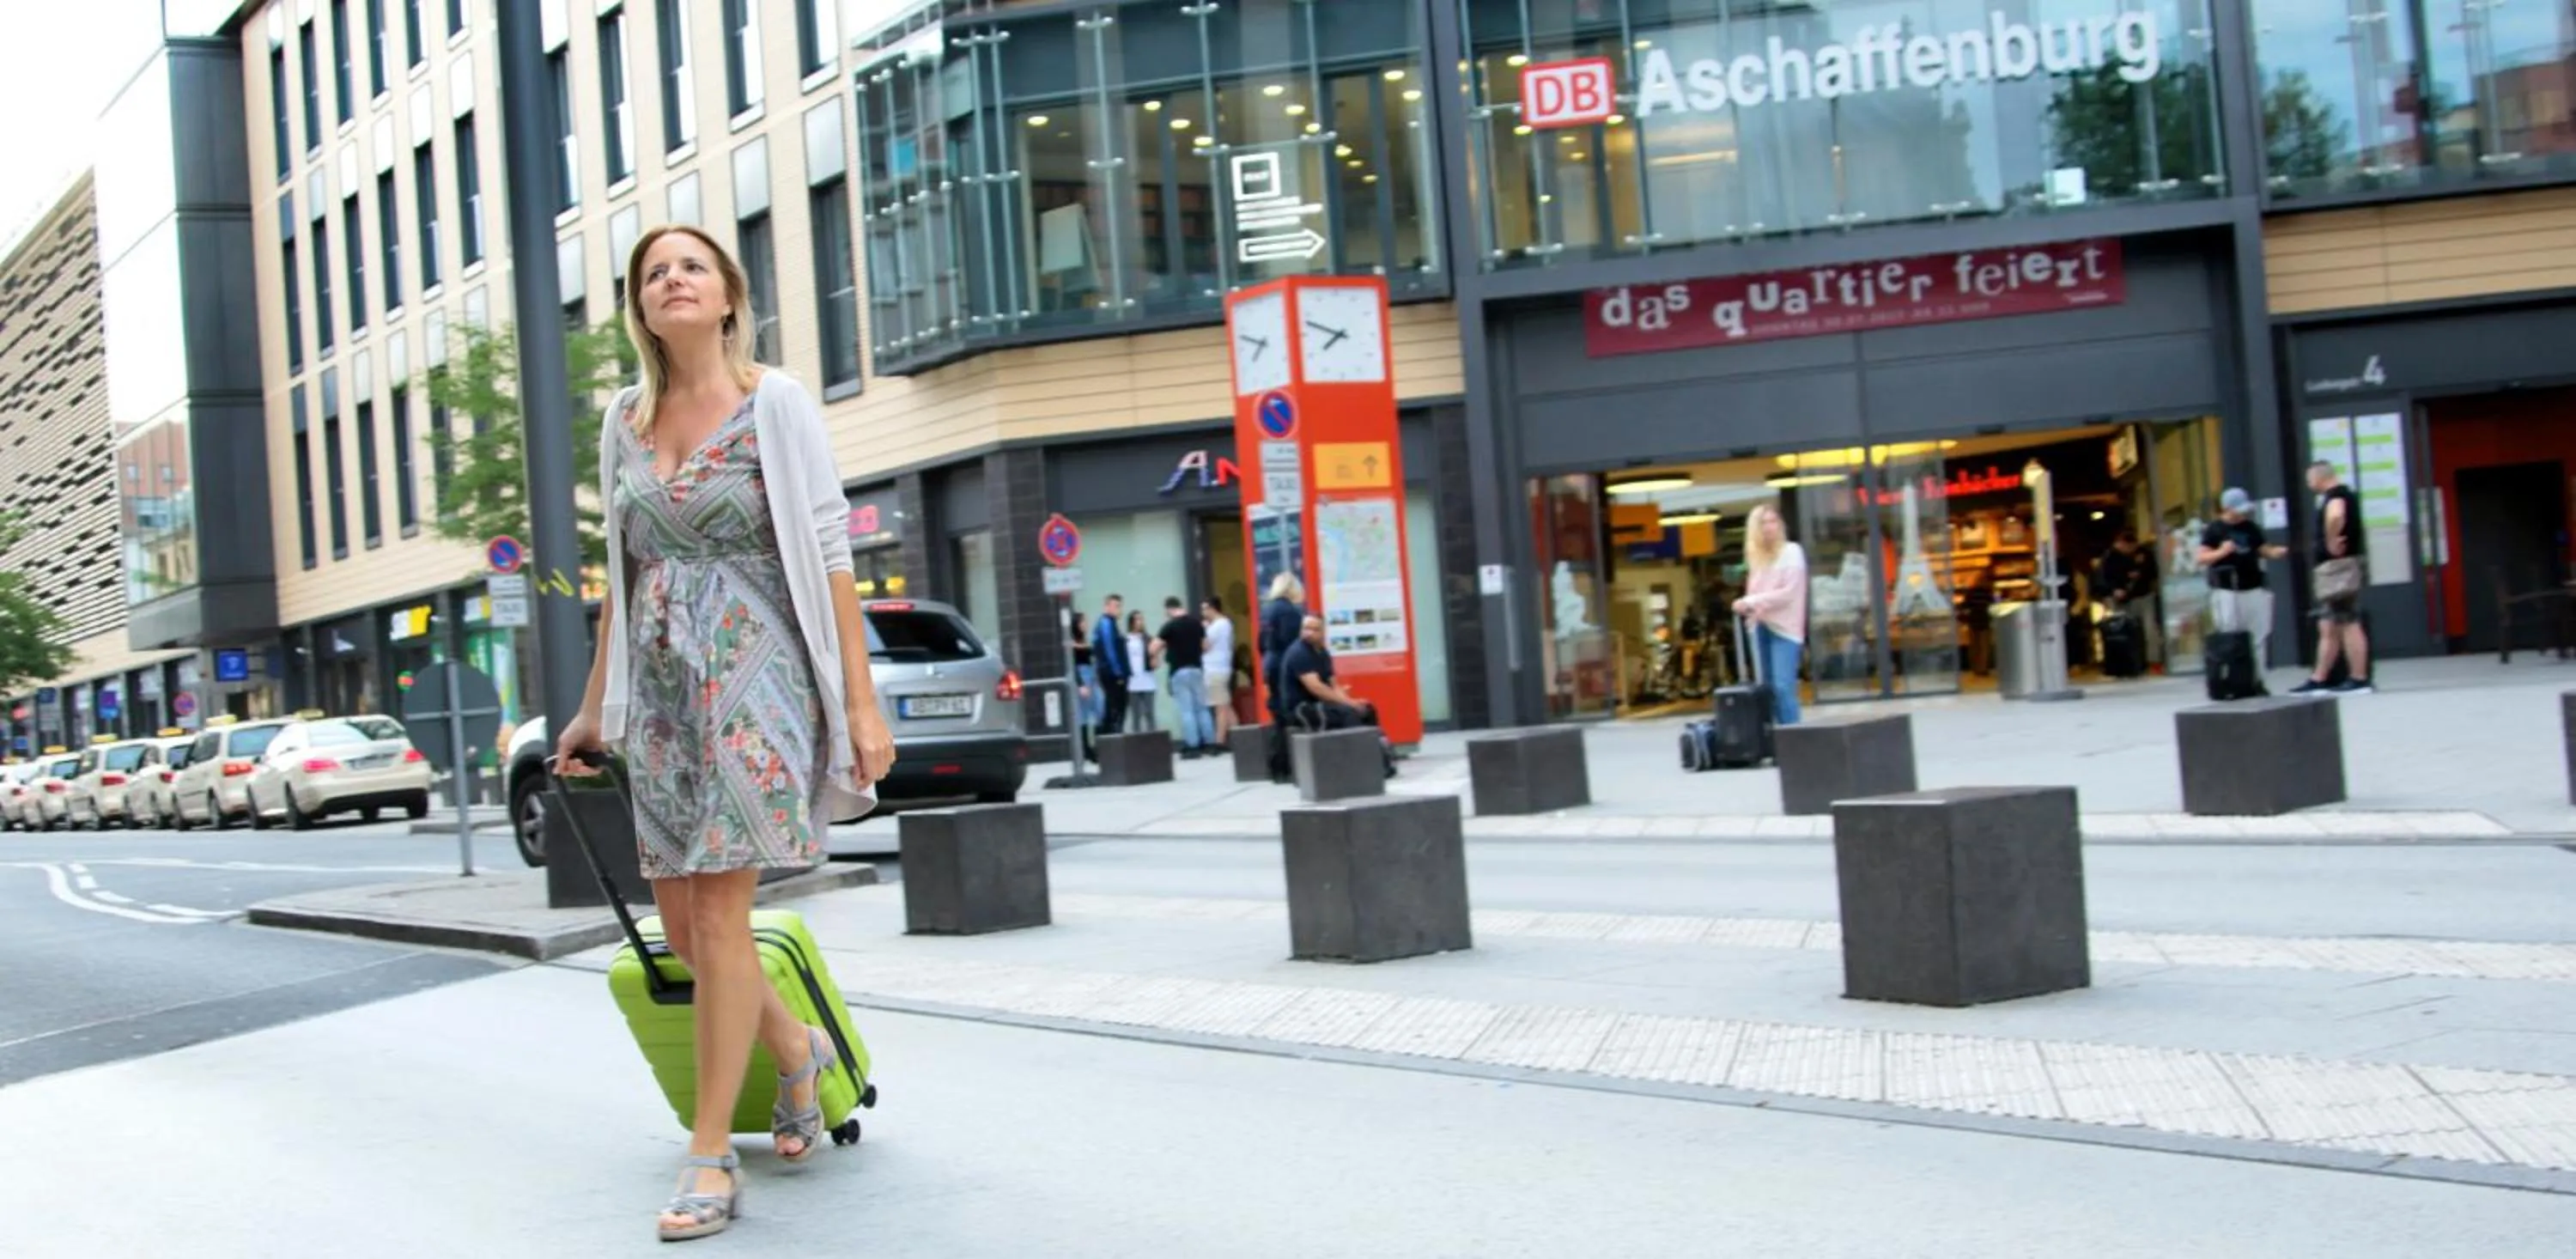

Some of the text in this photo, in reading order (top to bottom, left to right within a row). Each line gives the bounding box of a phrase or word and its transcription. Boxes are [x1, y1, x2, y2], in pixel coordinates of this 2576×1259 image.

[1534, 70, 1601, 116] DB
[1635, 8, 2160, 118] Aschaffenburg
[1601, 246, 2105, 338] das quartier feiert
[2363, 353, 2387, 386] 4
